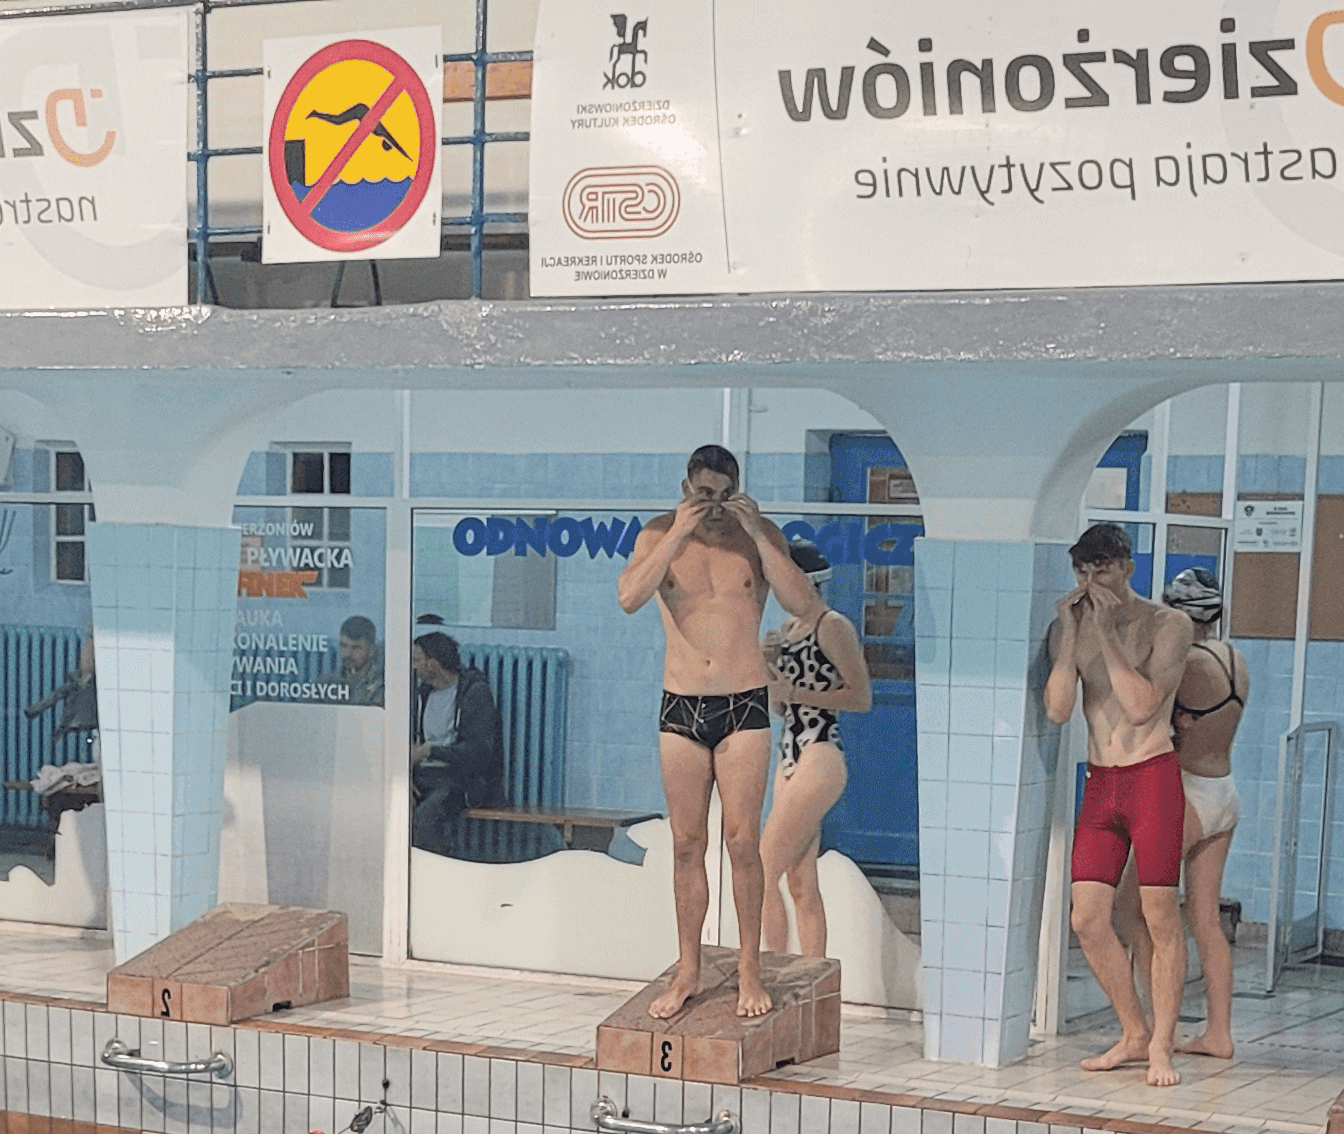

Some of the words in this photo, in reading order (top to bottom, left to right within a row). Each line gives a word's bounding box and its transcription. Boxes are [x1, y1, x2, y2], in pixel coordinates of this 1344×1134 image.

[242, 519, 314, 537] ERŻONIÓW
[247, 547, 354, 568] PŁYWACKA
[237, 609, 283, 627] AUKA
[235, 632, 329, 652] ONALENIE
[233, 656, 299, 675] WANIA
[256, 681, 350, 701] DOROSŁYCH
